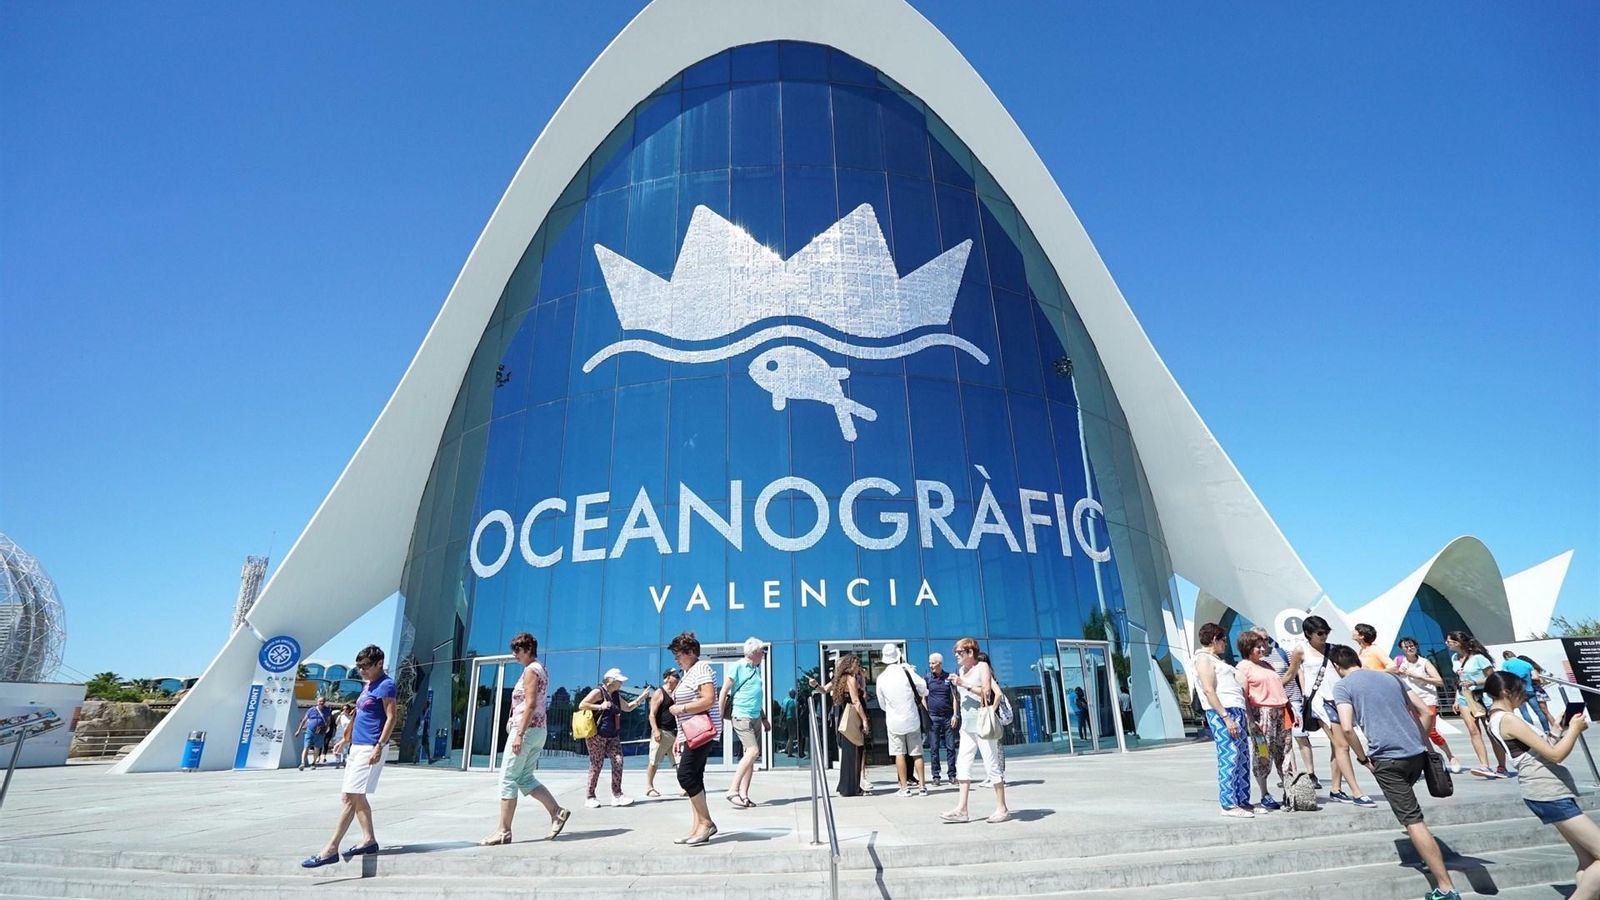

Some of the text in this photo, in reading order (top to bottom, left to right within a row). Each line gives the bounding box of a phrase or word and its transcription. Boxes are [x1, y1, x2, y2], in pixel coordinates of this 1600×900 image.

[469, 464, 1112, 579] OCEANOGRÀFIC
[648, 577, 940, 614] VALENCIA
[241, 687, 260, 743] MEETING POINT
